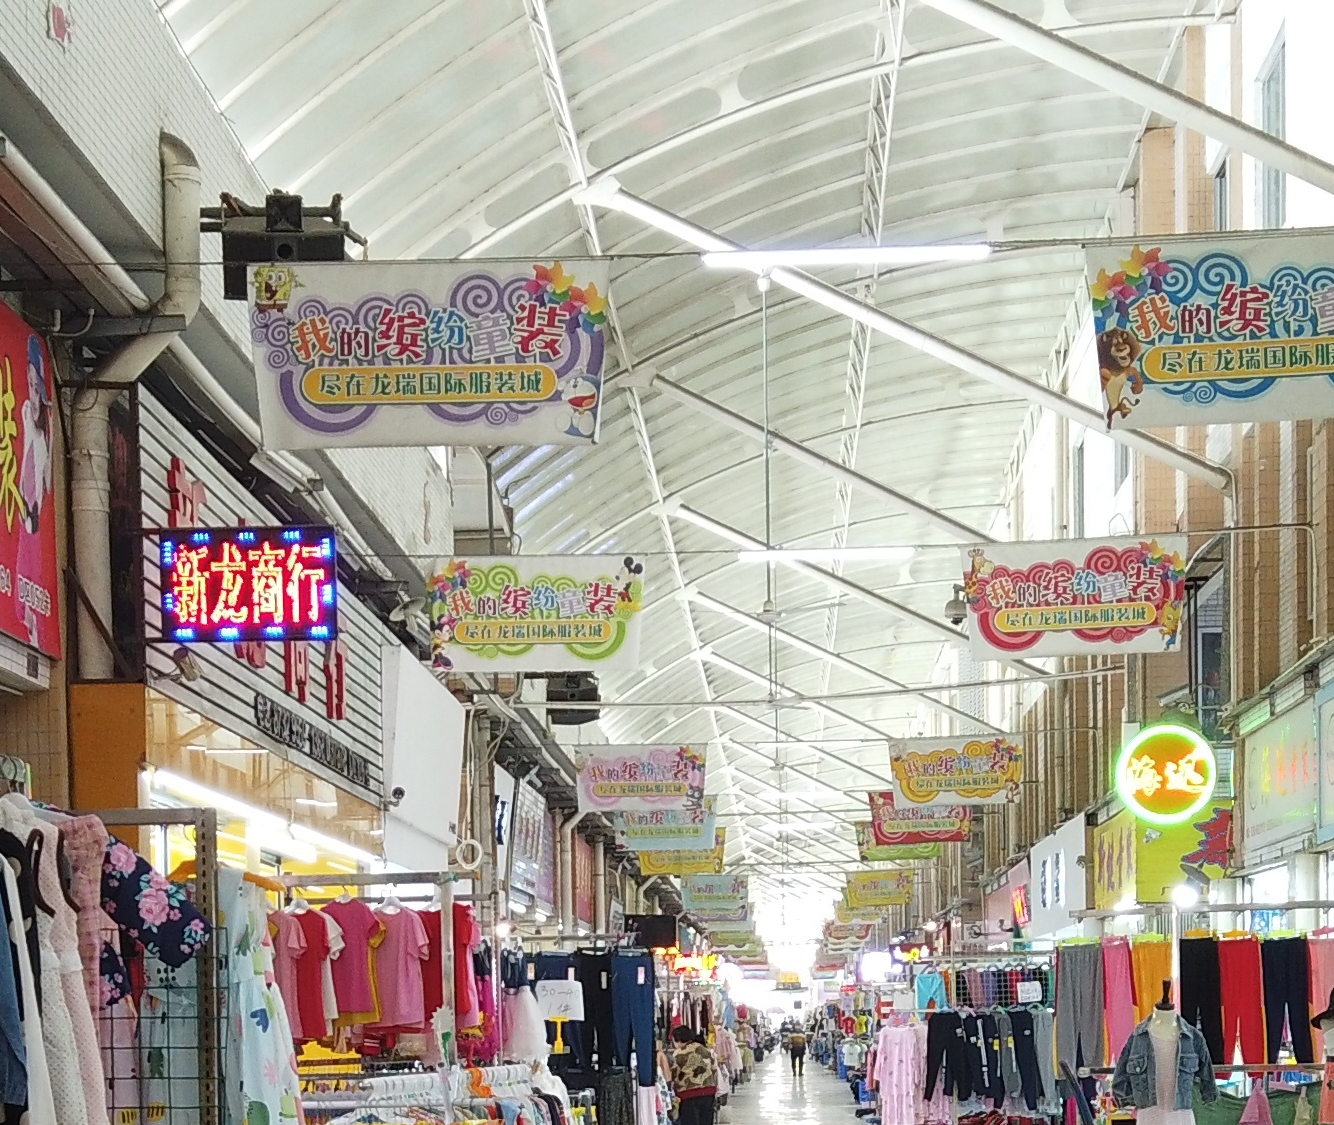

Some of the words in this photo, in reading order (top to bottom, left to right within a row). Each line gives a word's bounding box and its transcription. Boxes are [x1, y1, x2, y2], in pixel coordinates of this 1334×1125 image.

[290, 301, 570, 363] 我的缤纷童装
[319, 369, 543, 398] 尽在龙瑞国际服装城
[447, 581, 620, 618] 我的缤纷童装
[984, 562, 1164, 608] 我的缤纷童装
